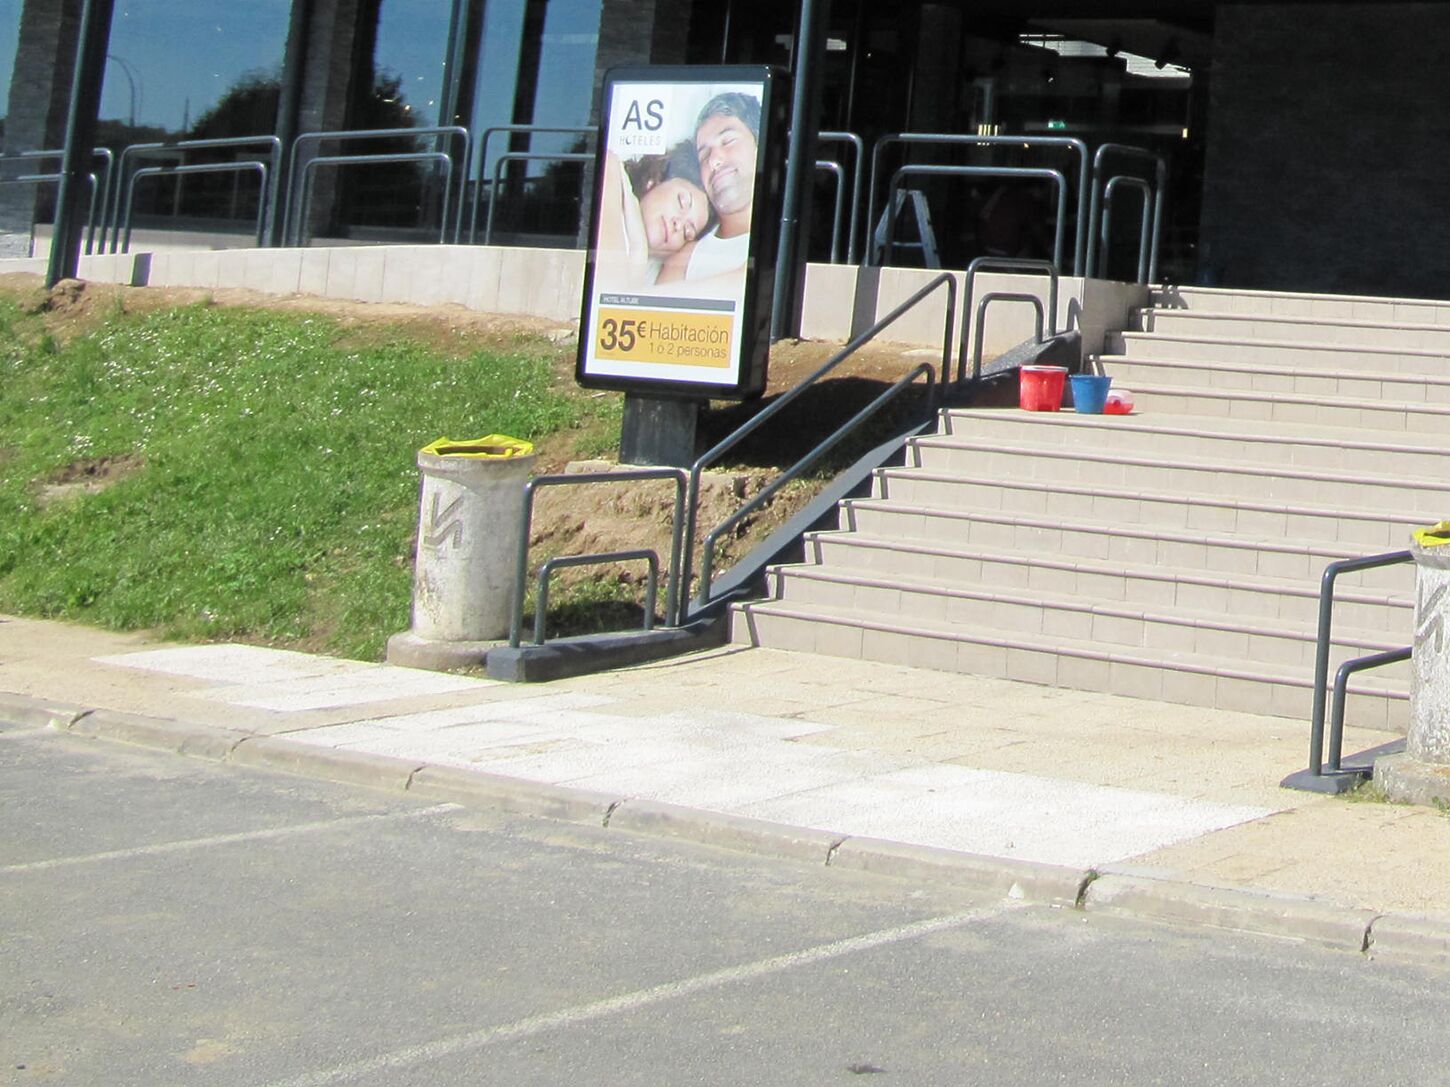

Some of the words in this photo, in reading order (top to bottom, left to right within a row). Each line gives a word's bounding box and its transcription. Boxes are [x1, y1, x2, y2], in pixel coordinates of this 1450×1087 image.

[622, 98, 664, 131] AS
[649, 322, 729, 344] Habitación
[649, 342, 654, 353] 1
[656, 345, 664, 353] o
[667, 343, 675, 355] 2
[676, 345, 728, 359] personas
